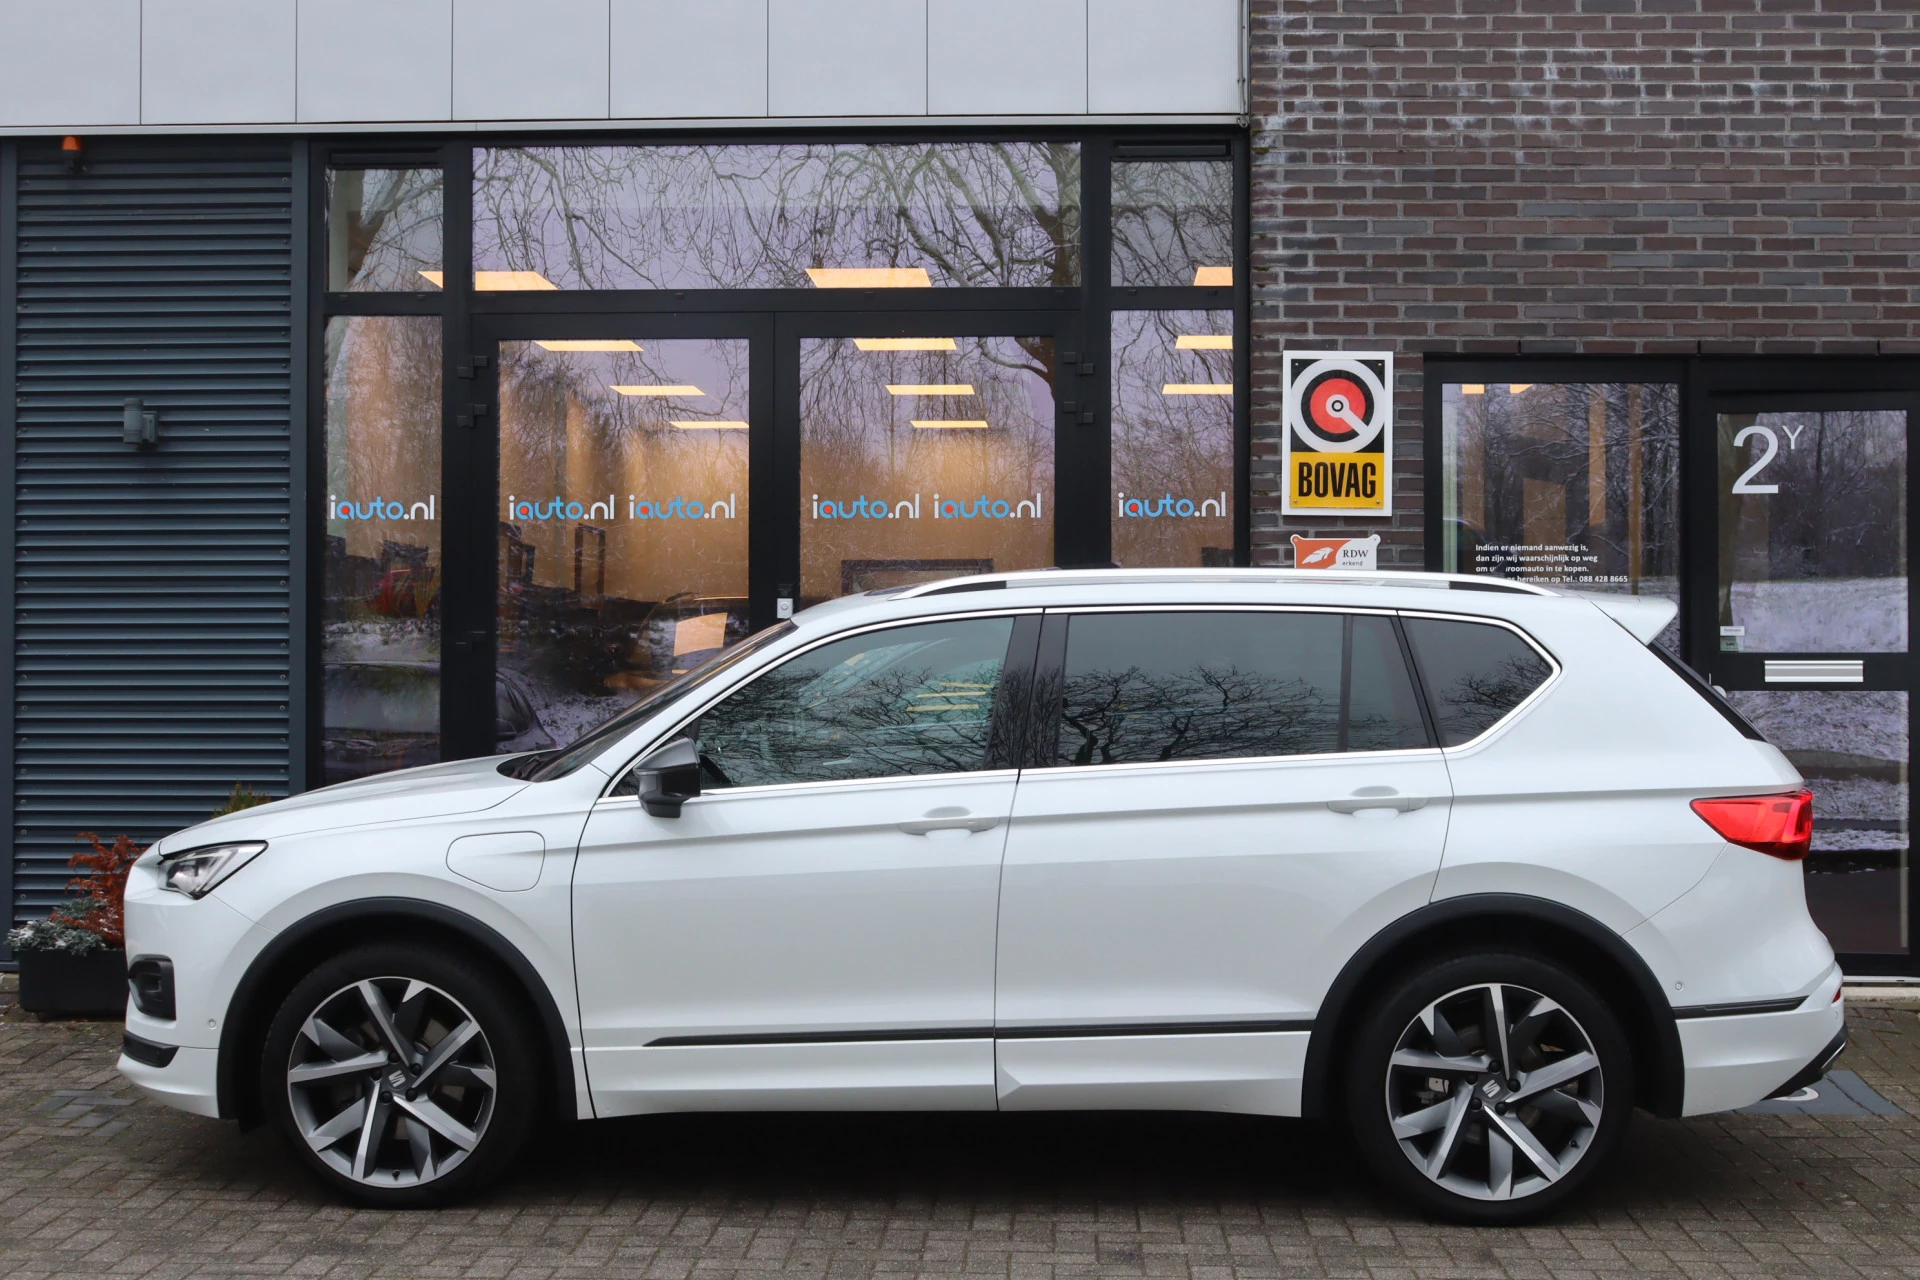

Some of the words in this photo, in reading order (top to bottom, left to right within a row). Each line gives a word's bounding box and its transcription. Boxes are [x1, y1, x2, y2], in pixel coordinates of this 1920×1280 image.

[1298, 462, 1377, 498] BOVAG
[330, 494, 435, 520] iauto.nl
[509, 494, 615, 520] iauto.nl
[629, 493, 735, 520] iauto.nl
[812, 493, 920, 519] iauto.nl
[934, 493, 1041, 519] iauto.nl
[1118, 491, 1226, 518] iauto.nl
[1343, 549, 1369, 558] RDW
[1544, 544, 1579, 552] aanwezig
[1580, 544, 1589, 552] is,
[1491, 555, 1504, 563] zijn
[1506, 555, 1518, 563] wij
[1519, 555, 1569, 563] waarschijnlijk
[1564, 565, 1589, 573] kopen.
[1579, 575, 1593, 583] 088
[1594, 575, 1608, 583] 428
[1609, 575, 1628, 583] 8665
